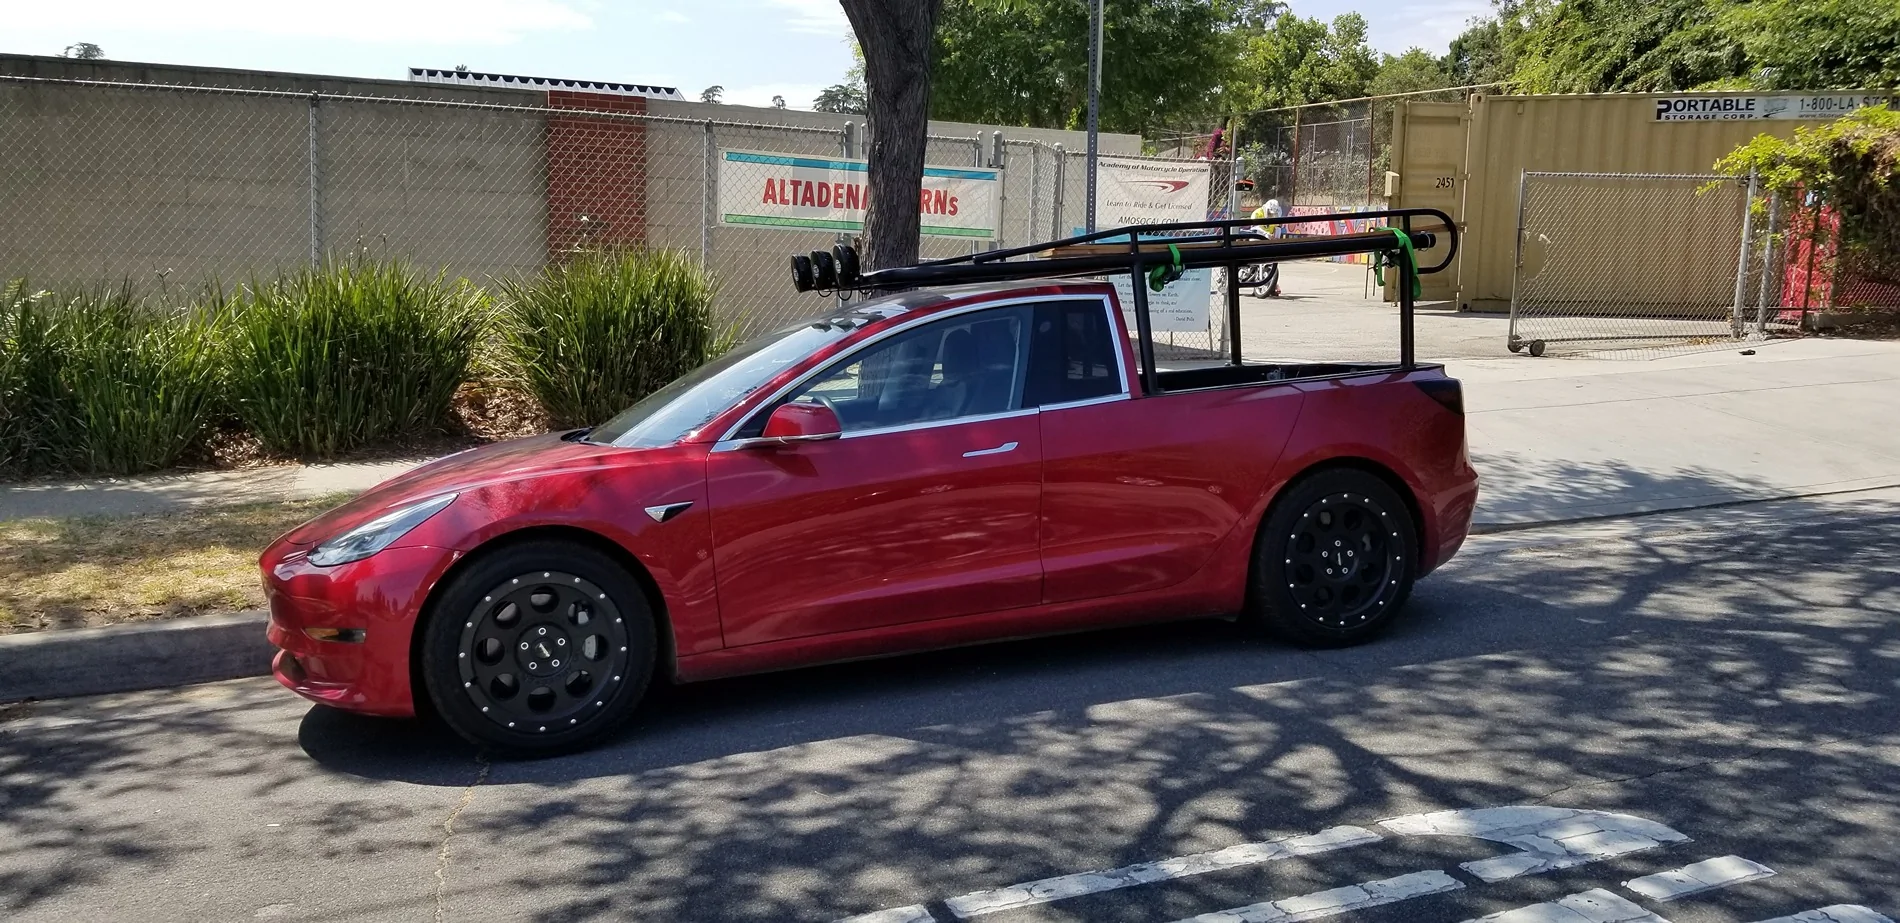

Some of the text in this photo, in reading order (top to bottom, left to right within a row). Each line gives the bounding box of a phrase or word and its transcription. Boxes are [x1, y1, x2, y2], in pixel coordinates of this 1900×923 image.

[1656, 98, 1756, 120] PORTABLE
[1098, 161, 1131, 170] Academy
[1141, 164, 1178, 172] Motorcycle
[920, 188, 959, 216] RNs
